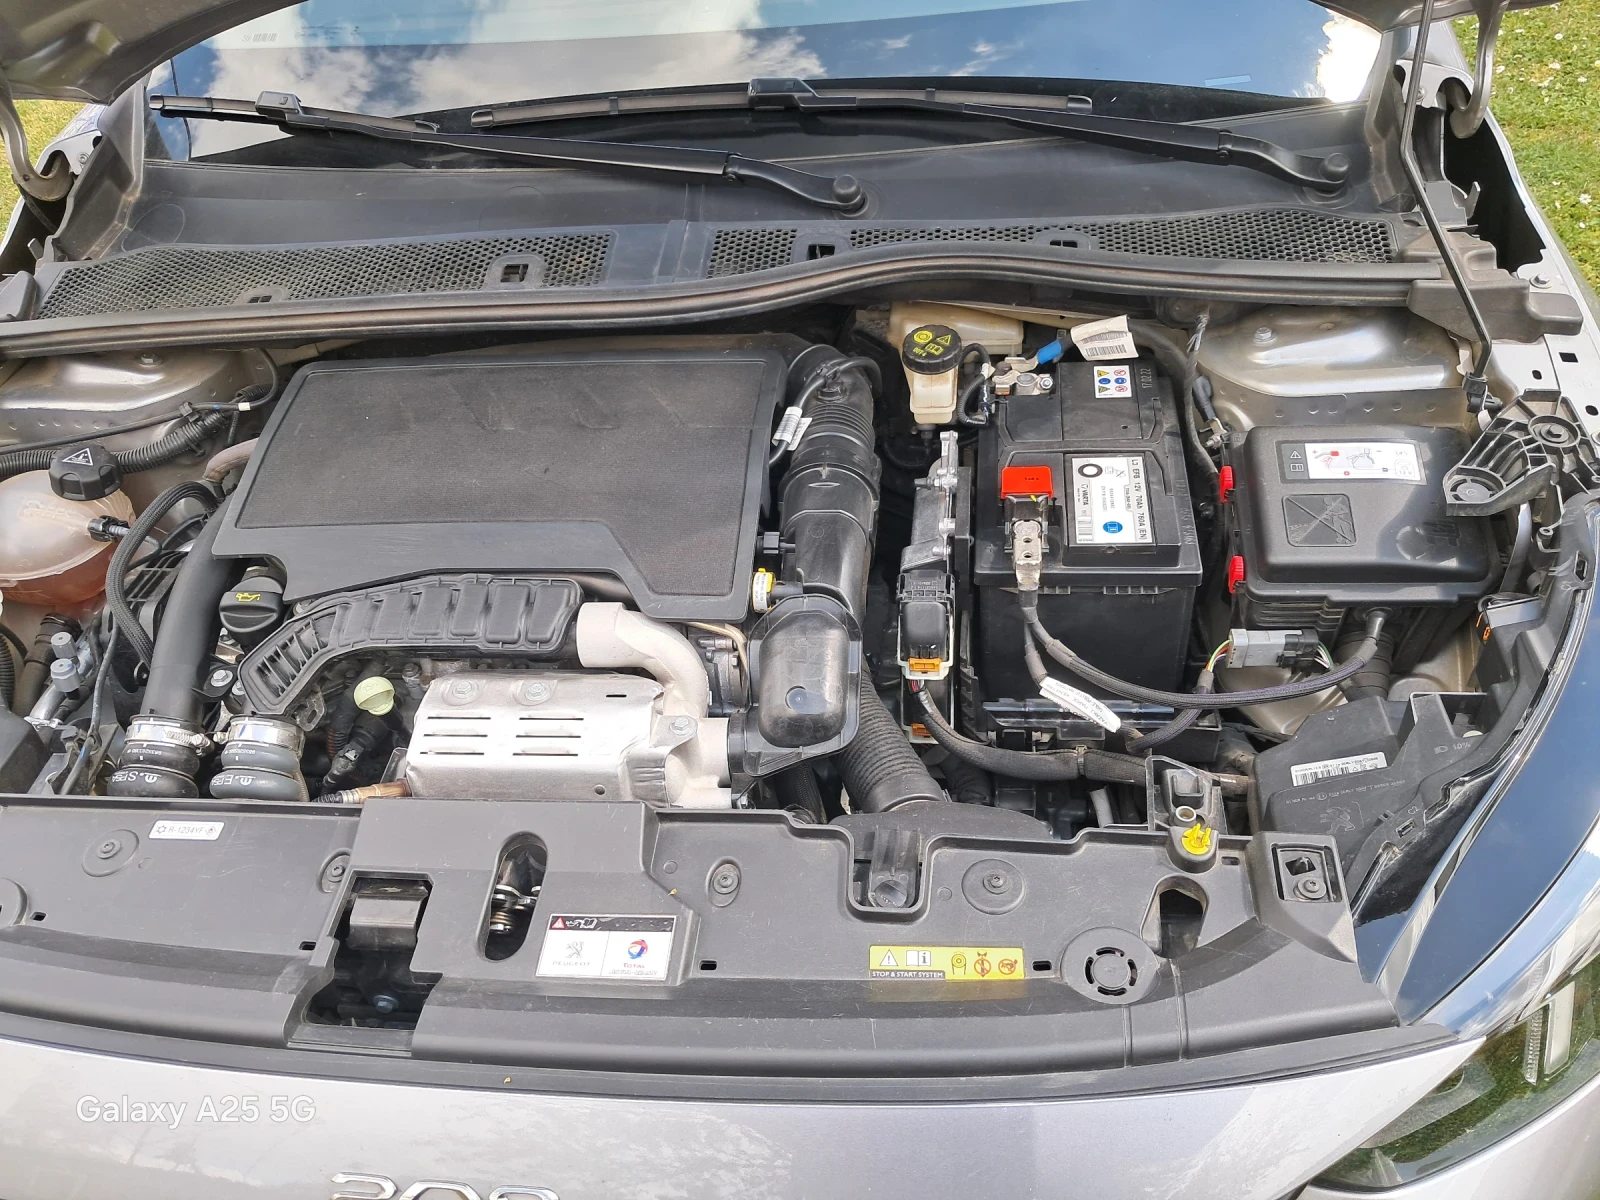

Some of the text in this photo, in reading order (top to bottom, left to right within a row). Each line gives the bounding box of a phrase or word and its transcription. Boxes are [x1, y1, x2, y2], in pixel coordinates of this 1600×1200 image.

[1132, 468, 1140, 479] EFB
[1134, 482, 1142, 492] 12V
[1136, 495, 1144, 510] 70Ah
